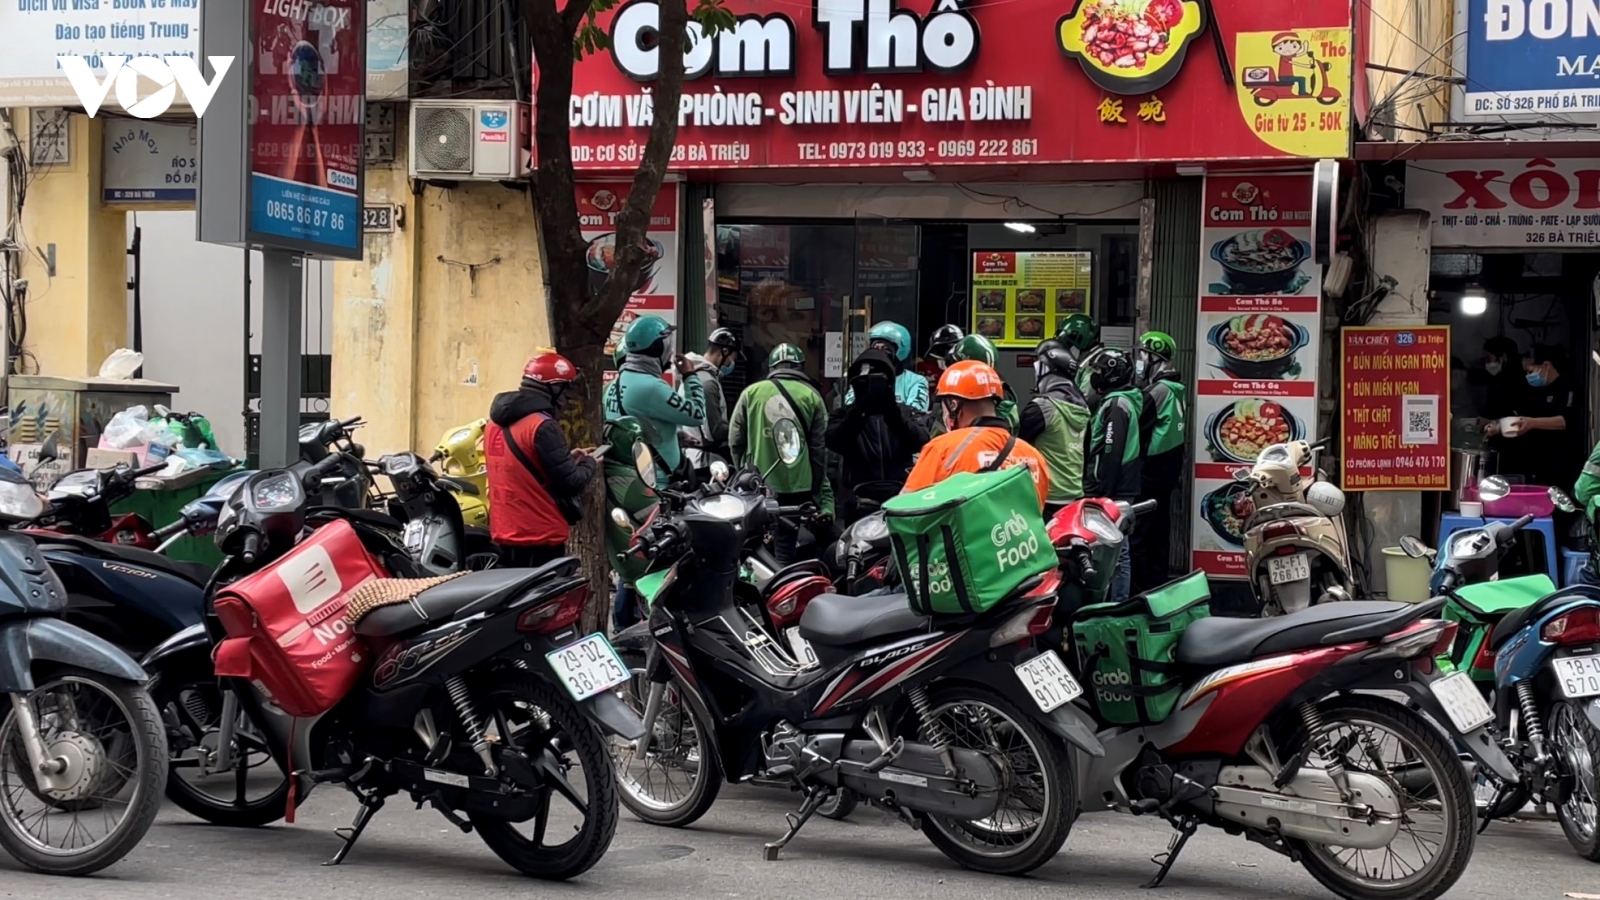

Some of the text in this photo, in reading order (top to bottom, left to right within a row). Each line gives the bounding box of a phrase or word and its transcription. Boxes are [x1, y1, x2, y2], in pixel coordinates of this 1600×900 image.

[55, 23, 80, 40] Đào
[85, 24, 106, 42] tạo
[110, 19, 145, 40] tiếng
[150, 21, 189, 39] Trung
[569, 91, 623, 127] CƠM
[678, 84, 762, 127] PHÒNG
[779, 90, 841, 126] SINH
[844, 83, 904, 123] VIÊN
[921, 88, 967, 123] GIA
[970, 80, 1032, 122] ĐÌNH
[1496, 93, 1511, 111] SỐ
[1514, 97, 1534, 110] 326
[1537, 92, 1559, 109] PHỐ
[1563, 93, 1577, 108] BÀ
[1293, 112, 1306, 131] 25
[1319, 111, 1342, 131] 50K
[597, 143, 615, 162] CƠ
[618, 140, 638, 162] SỞ
[688, 142, 707, 161] BÀ
[709, 142, 750, 163] TRIỆU
[798, 143, 826, 160] TEL:
[829, 142, 866, 159] 0973
[870, 142, 894, 158] 019
[898, 141, 925, 158] 933
[938, 140, 976, 157] 0969
[979, 140, 1008, 156] 222
[1012, 139, 1038, 156] 861
[267, 200, 345, 230] 0865 86 87 86
[1442, 215, 1458, 228] THỊT
[1485, 212, 1500, 226] CHẢ
[1508, 213, 1533, 226] TRỨNG
[1541, 215, 1558, 226] PATE
[1566, 215, 1581, 228] LẠP
[1526, 232, 1545, 243] 326
[1549, 230, 1565, 243] BÀ
[1397, 333, 1413, 344] 326
[1353, 349, 1444, 373] BÚN MIẾN NGAN TRỘN
[1353, 376, 1419, 396] BÚN MIẾN NGAN
[1353, 404, 1369, 427] THỊT
[1105, 421, 1113, 444] gojek
[1353, 432, 1379, 449] MĂNG
[1381, 429, 1396, 449] TIẾT
[1395, 456, 1414, 468] 0946
[1416, 456, 1429, 468] 476
[1431, 456, 1445, 468] 170
[990, 509, 1029, 548] Grab
[996, 530, 1039, 572] Food
[102, 562, 157, 579] VISION
[1273, 566, 1307, 582] 266.13
[311, 651, 333, 669] Food
[558, 641, 605, 671] 29-D2
[860, 642, 925, 667] BLADE
[1092, 668, 1129, 685] Grab
